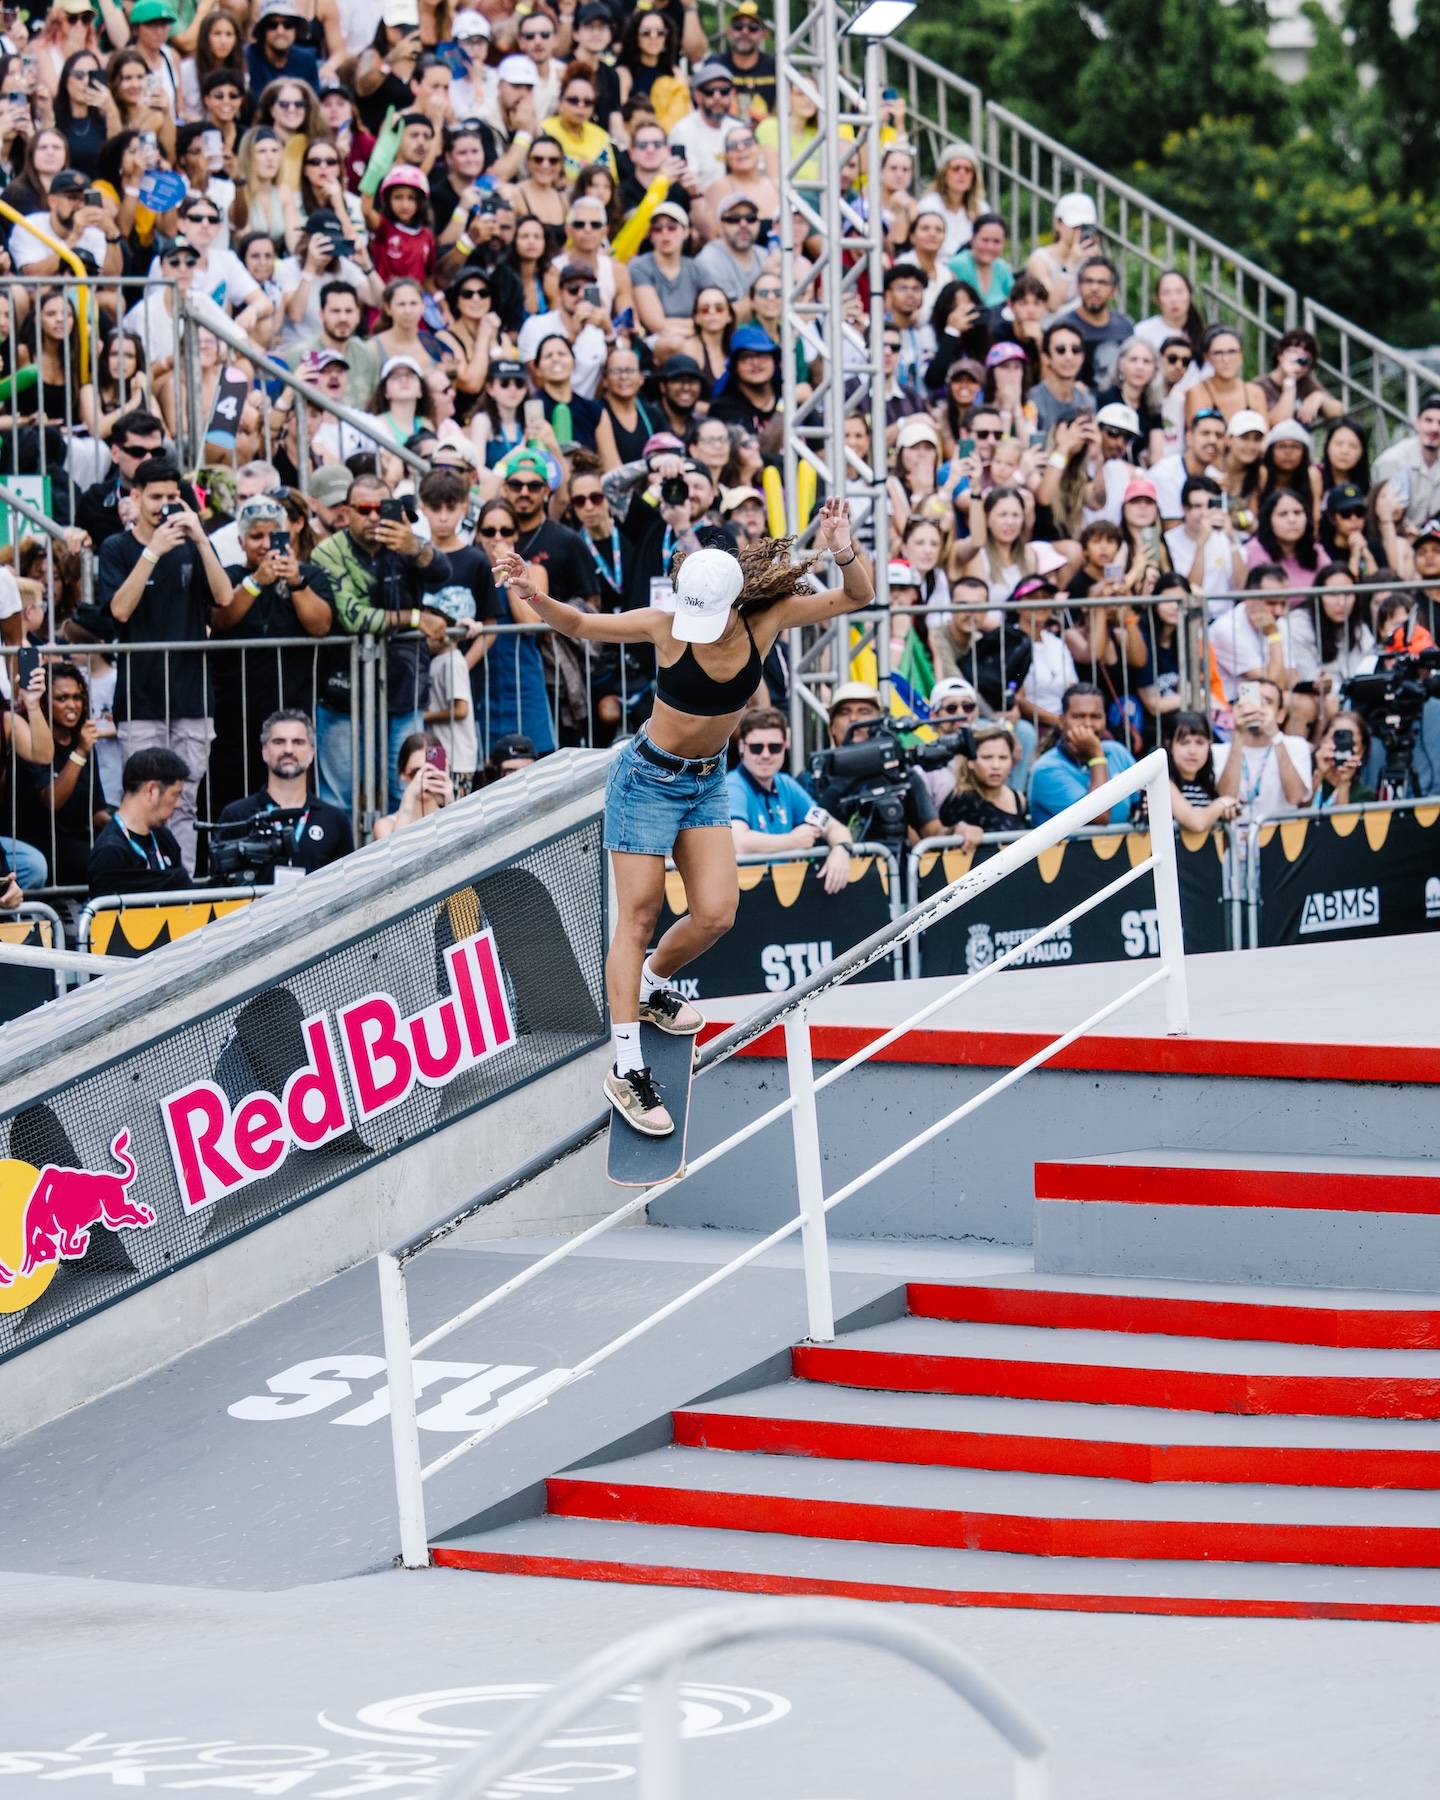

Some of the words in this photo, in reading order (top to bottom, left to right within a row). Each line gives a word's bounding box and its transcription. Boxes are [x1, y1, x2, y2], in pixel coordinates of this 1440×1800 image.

[216, 396, 238, 421] 4
[684, 595, 705, 609] Nike
[1303, 887, 1379, 926] ABMS
[1026, 940, 1073, 964] PAULO
[1121, 910, 1160, 956] ST
[168, 1019, 346, 1206] Red
[343, 936, 511, 1115] Bull
[227, 1354, 595, 1432] STU
